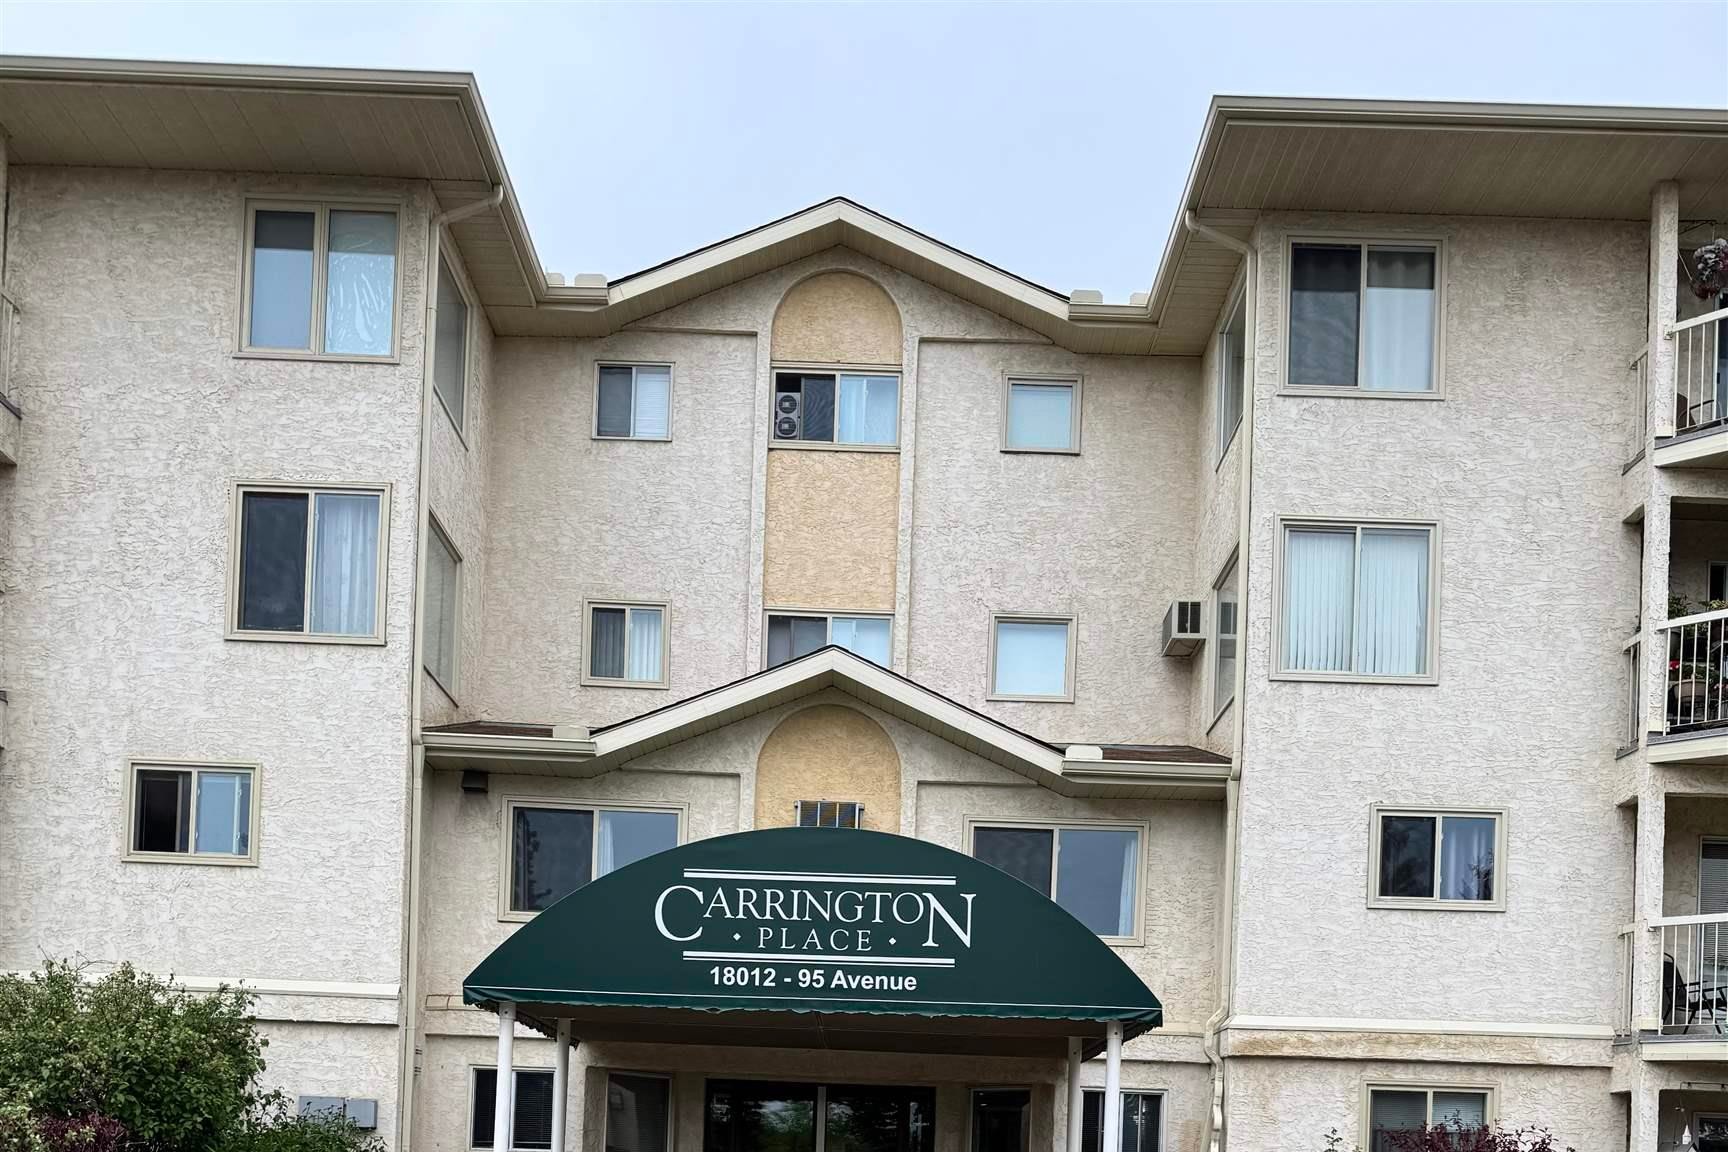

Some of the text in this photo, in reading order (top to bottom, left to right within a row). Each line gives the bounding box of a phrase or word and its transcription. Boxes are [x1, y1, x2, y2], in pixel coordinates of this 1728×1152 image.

[654, 885, 977, 949] CARRINGTON
[757, 926, 872, 952] PLACE
[709, 966, 776, 987] 18012
[797, 968, 825, 989] 95
[830, 969, 918, 991] Avenue
